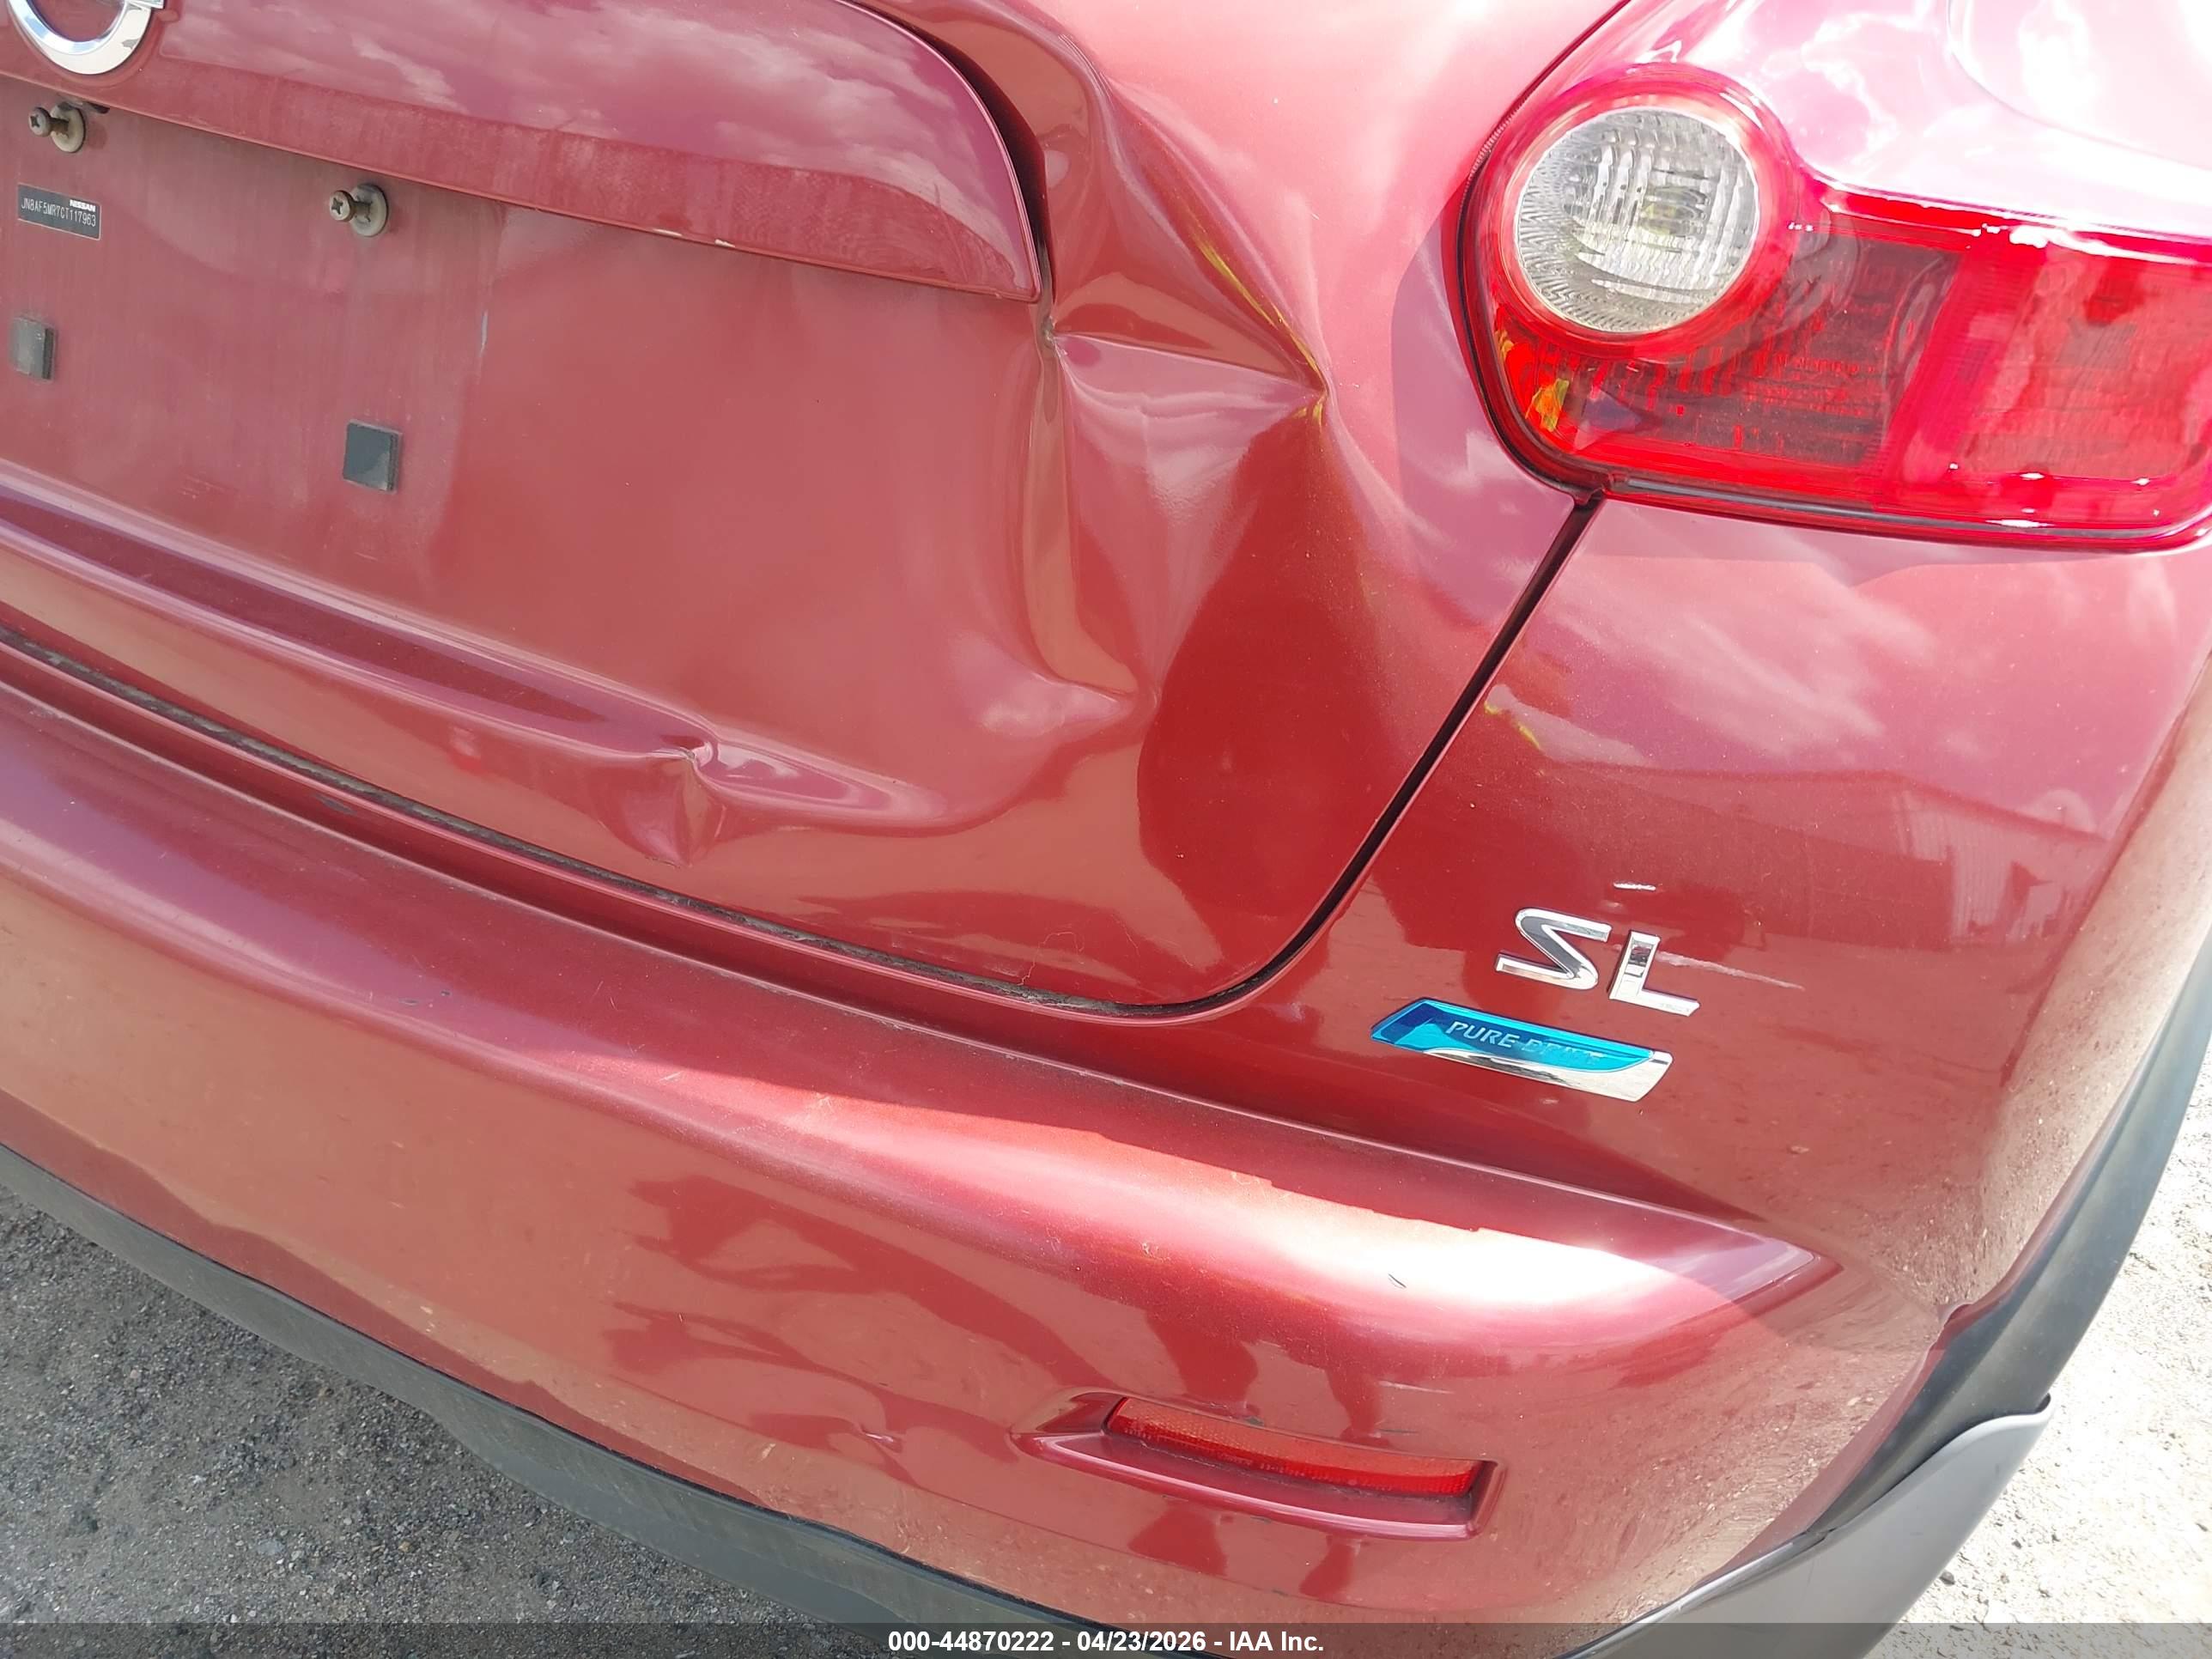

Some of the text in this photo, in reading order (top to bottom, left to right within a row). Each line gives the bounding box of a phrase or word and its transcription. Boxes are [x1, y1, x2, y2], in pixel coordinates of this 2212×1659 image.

[21, 198, 96, 227] JN8AF5MR7CT117963
[70, 199, 96, 212] NISSAN
[1495, 907, 1700, 1016] SL
[1445, 1021, 1520, 1048] PURE
